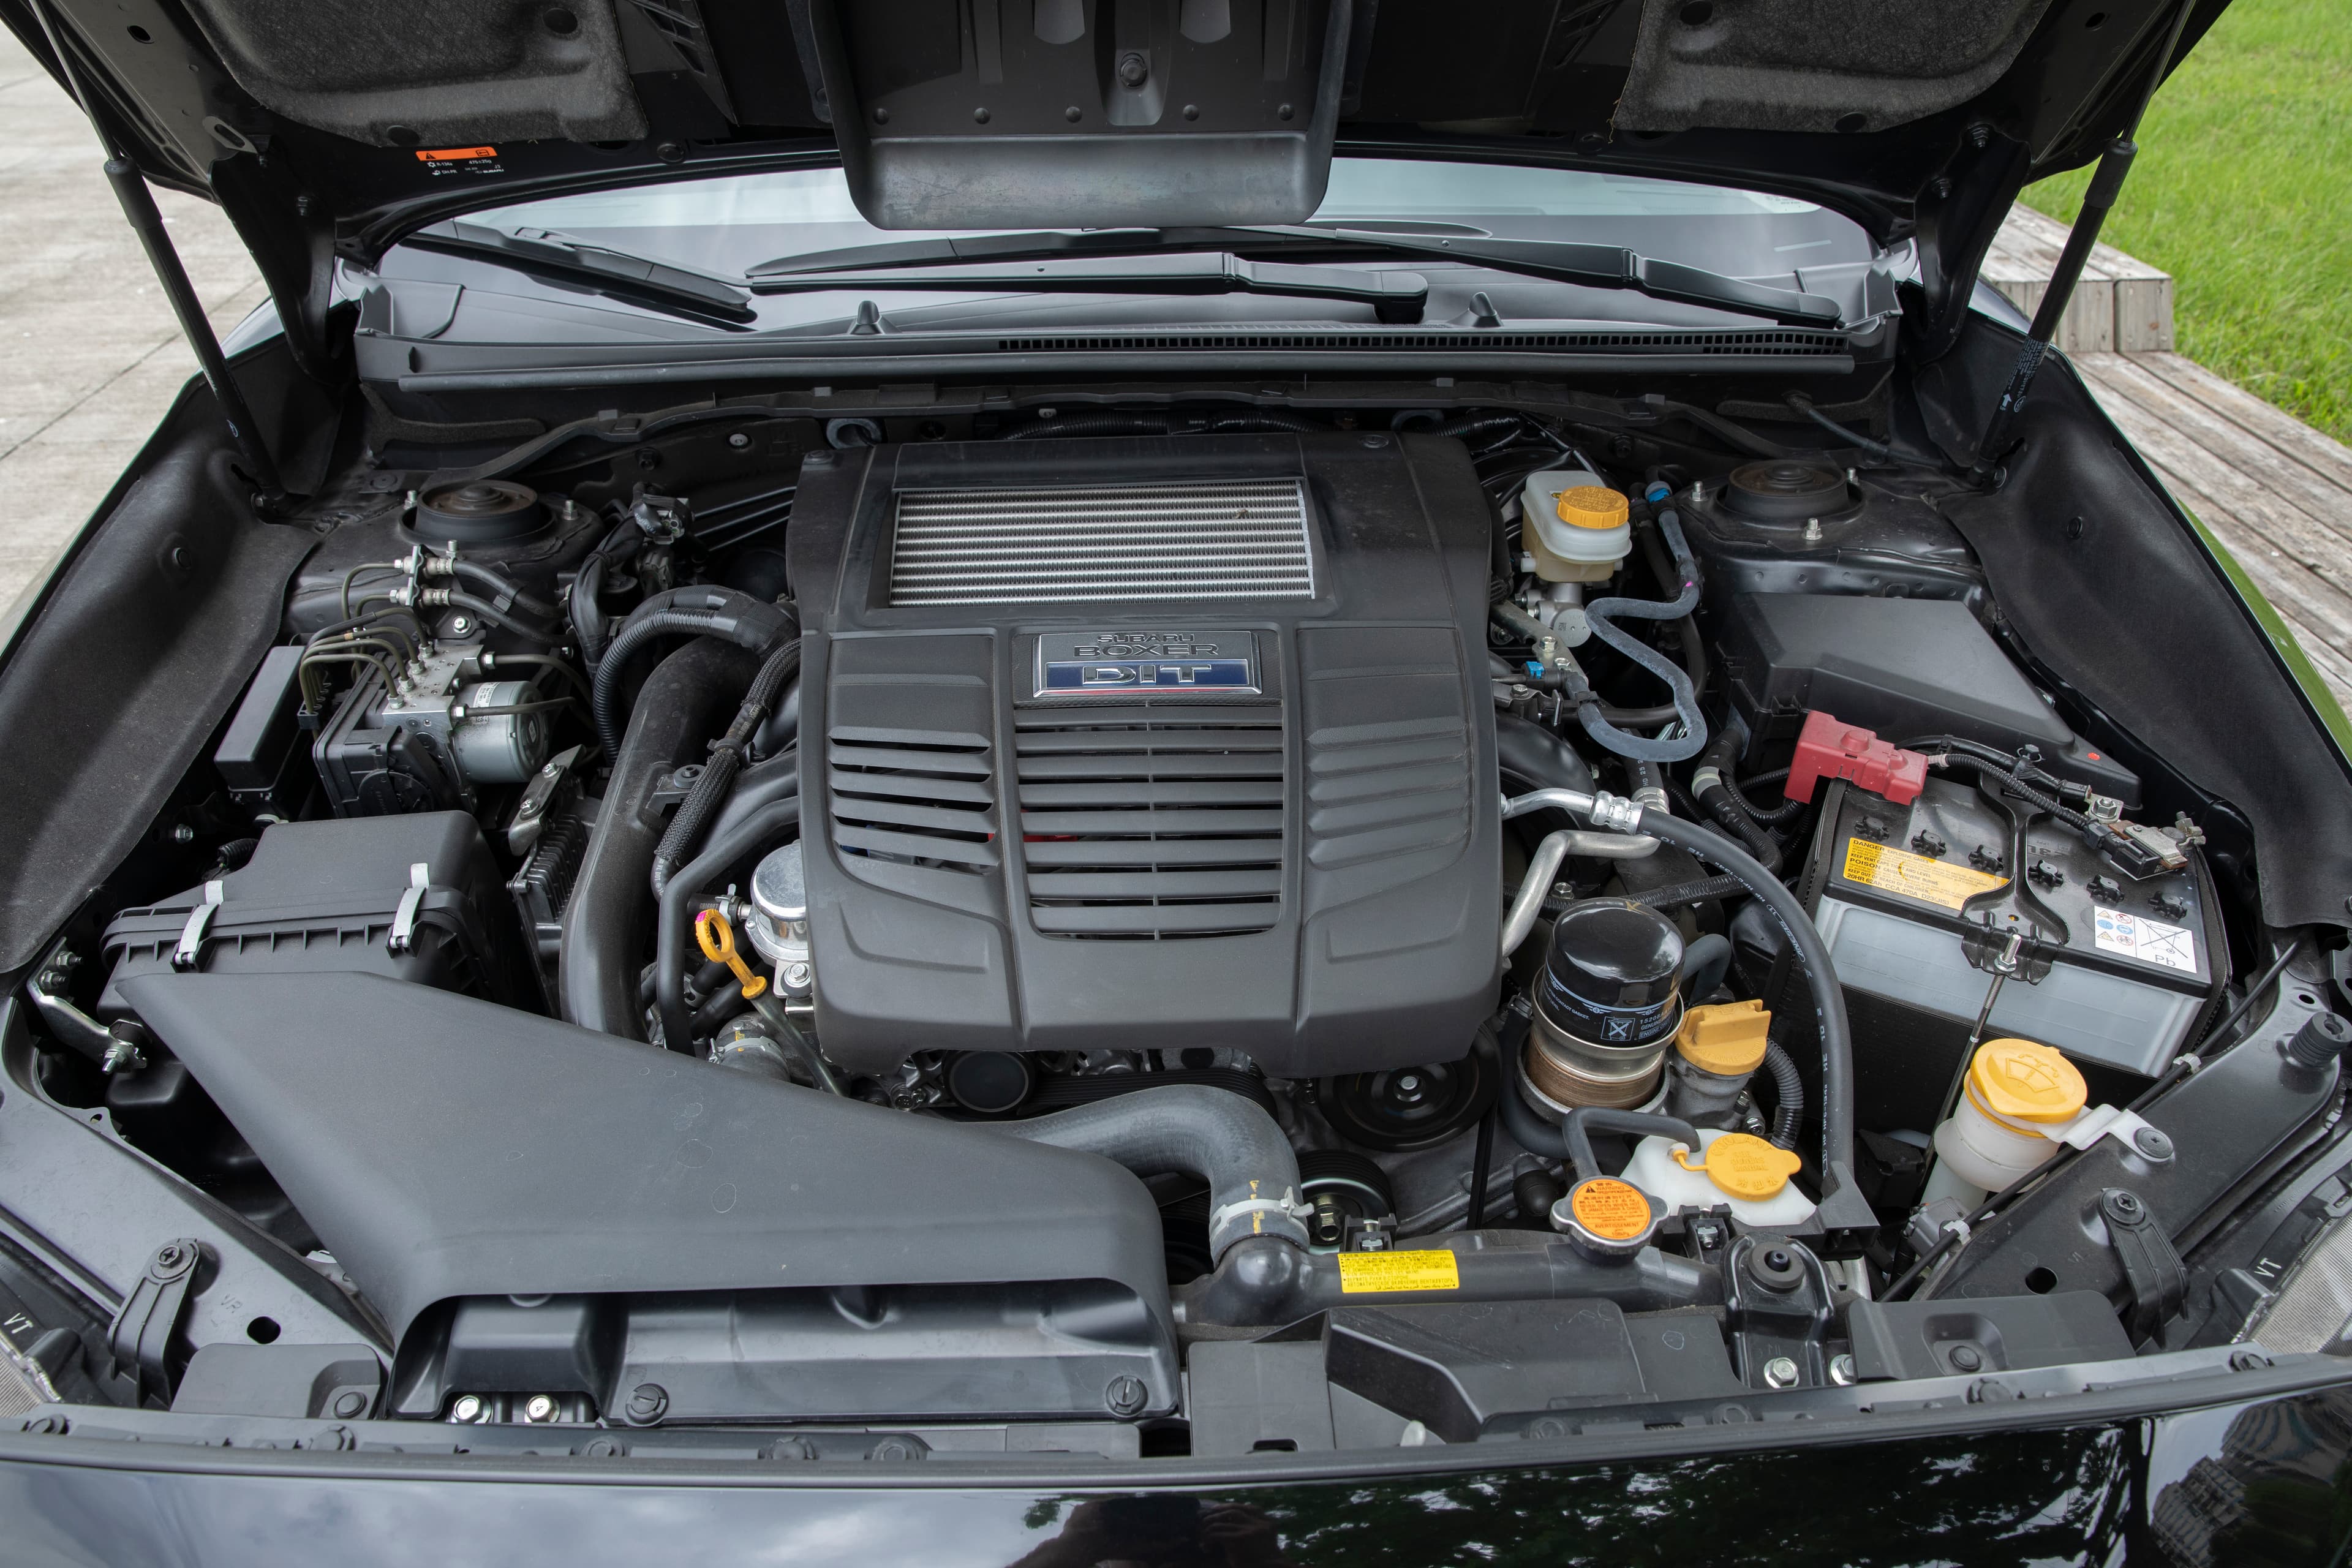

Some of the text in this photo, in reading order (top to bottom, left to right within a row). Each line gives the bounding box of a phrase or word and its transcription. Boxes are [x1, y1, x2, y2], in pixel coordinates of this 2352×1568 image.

[1098, 634, 1195, 643] SUBARU
[1074, 644, 1219, 657] BOXER
[1082, 664, 1212, 685] DIT
[1853, 840, 1885, 851] DANGER
[1850, 858, 1881, 870] POISON
[1847, 873, 1864, 882] 20HR
[1866, 878, 1882, 887] 62Ah
[1885, 883, 1900, 892] CCA
[1921, 893, 1950, 905] D23(JIS)
[2155, 954, 2176, 967] Pb
[1711, 1136, 1773, 1156] COOLANT
[2254, 1257, 2282, 1278] VT
[4, 1312, 33, 1334] VT
